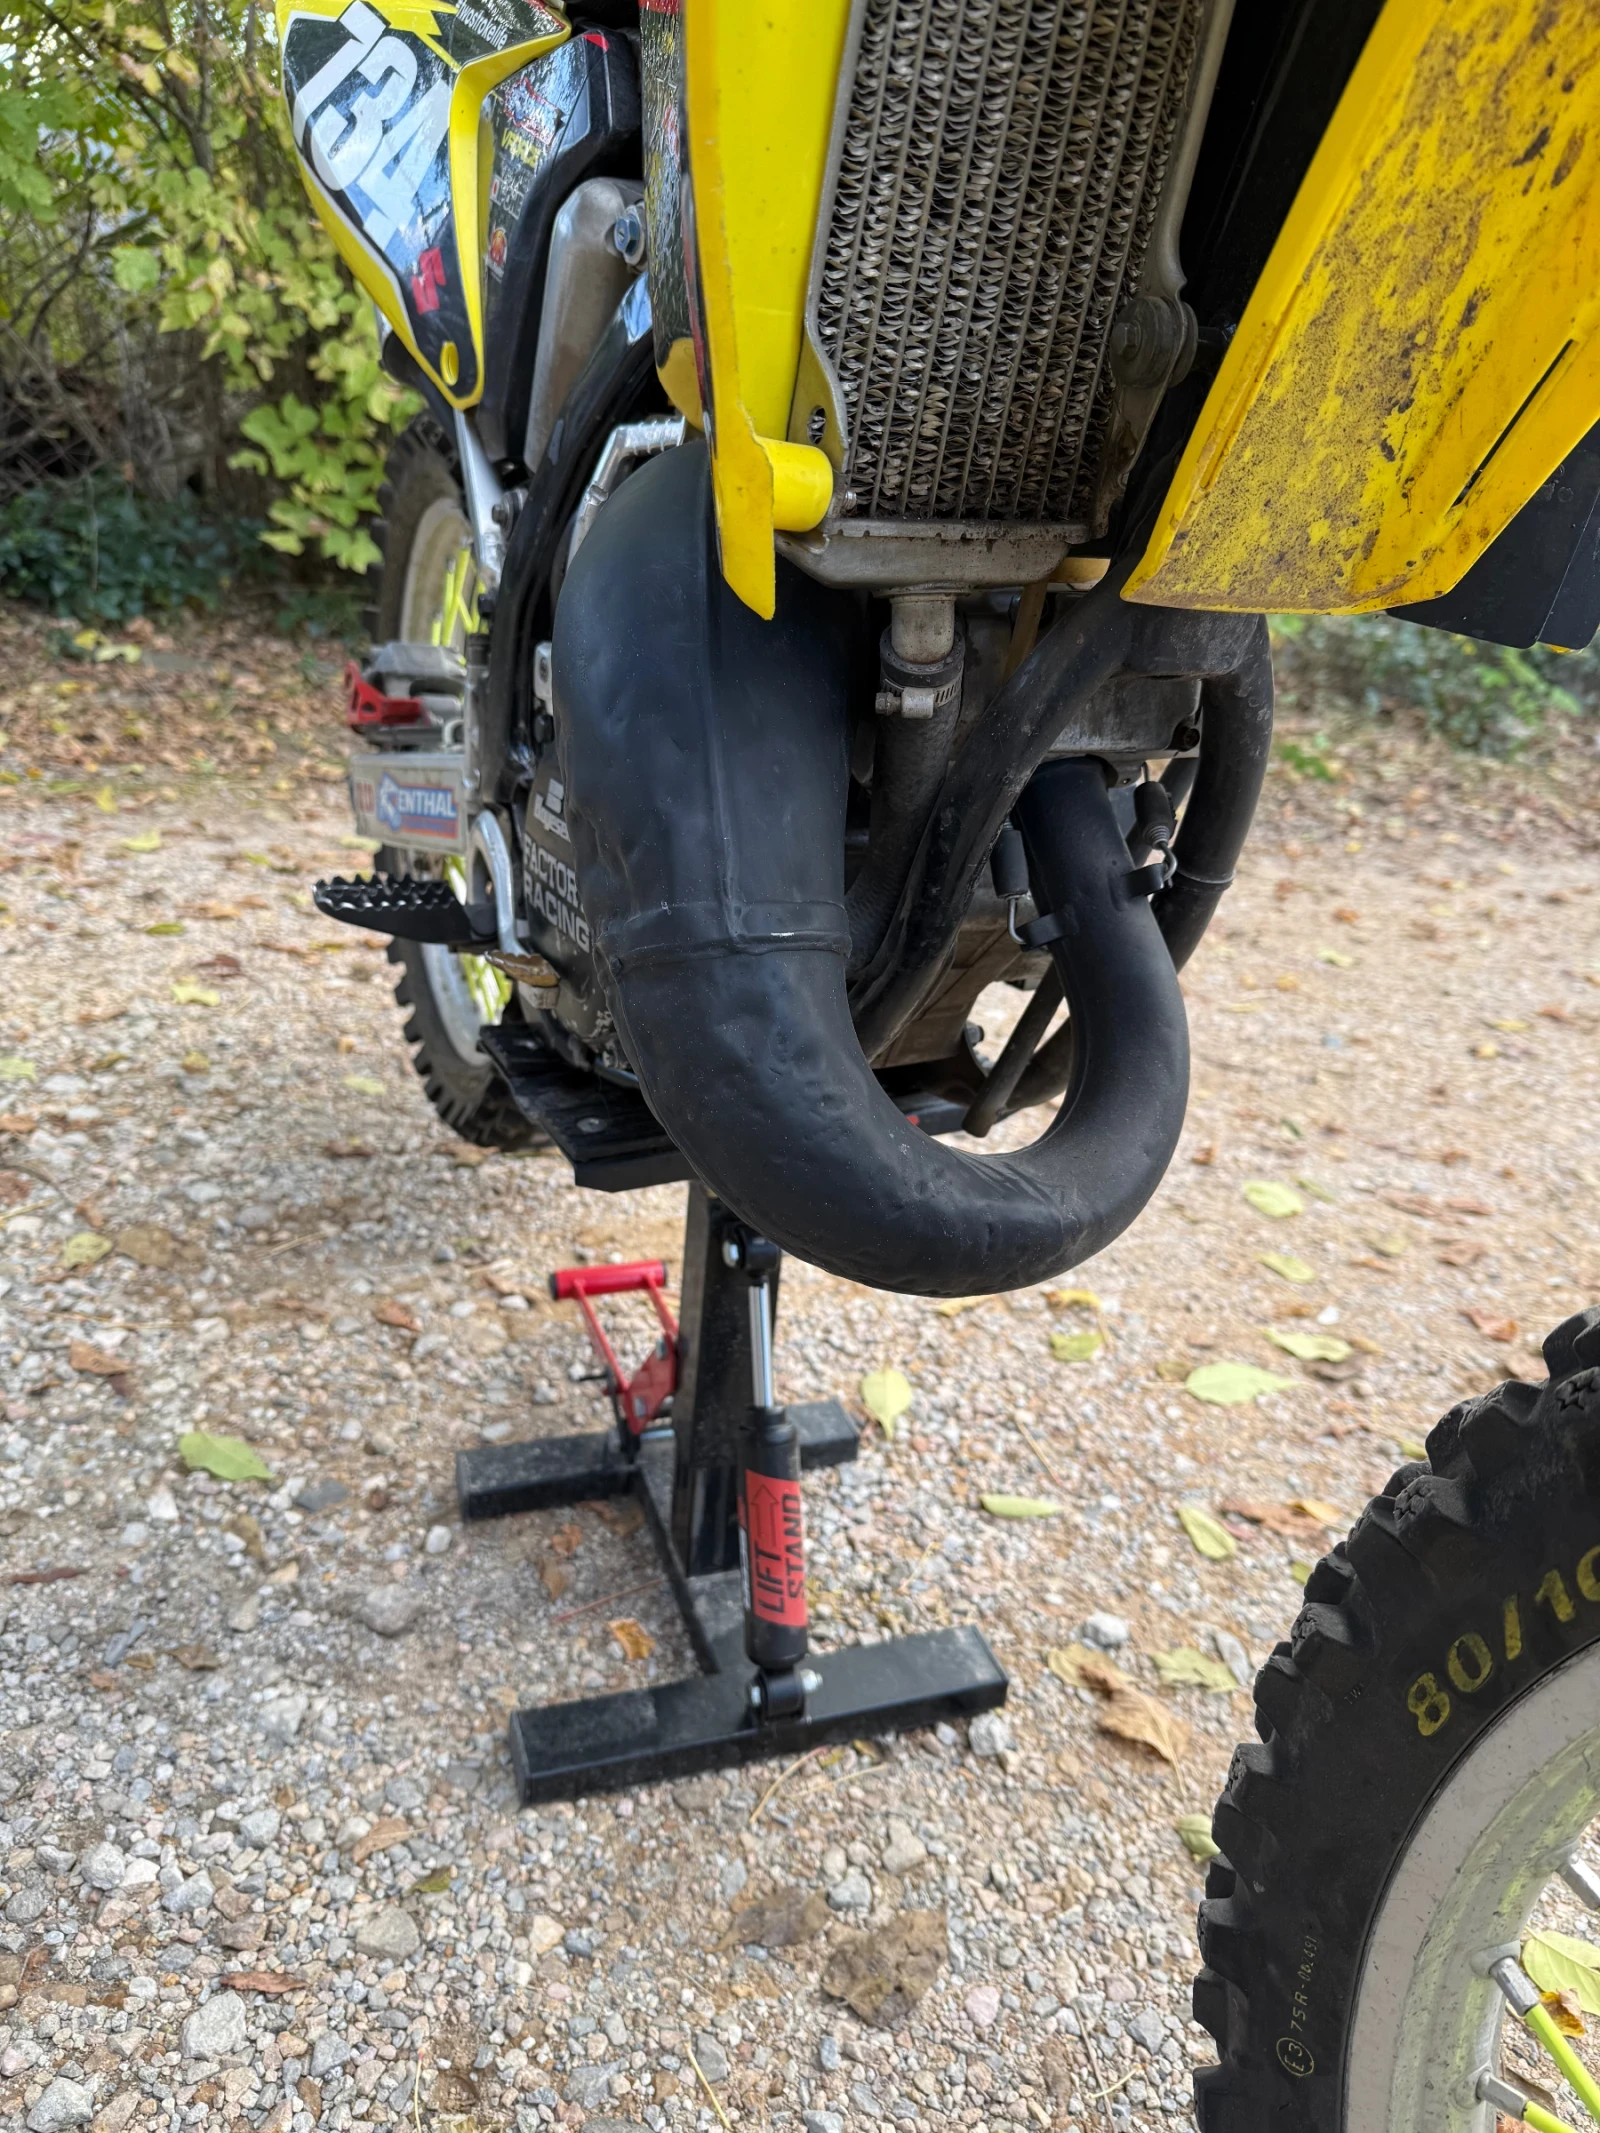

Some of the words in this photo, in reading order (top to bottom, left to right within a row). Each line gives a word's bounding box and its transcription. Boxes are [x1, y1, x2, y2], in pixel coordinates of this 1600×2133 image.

[523, 833, 585, 913] FACTOR
[523, 871, 591, 953] RACING
[755, 1540, 785, 1613] LIFT
[782, 1494, 805, 1599] STAND
